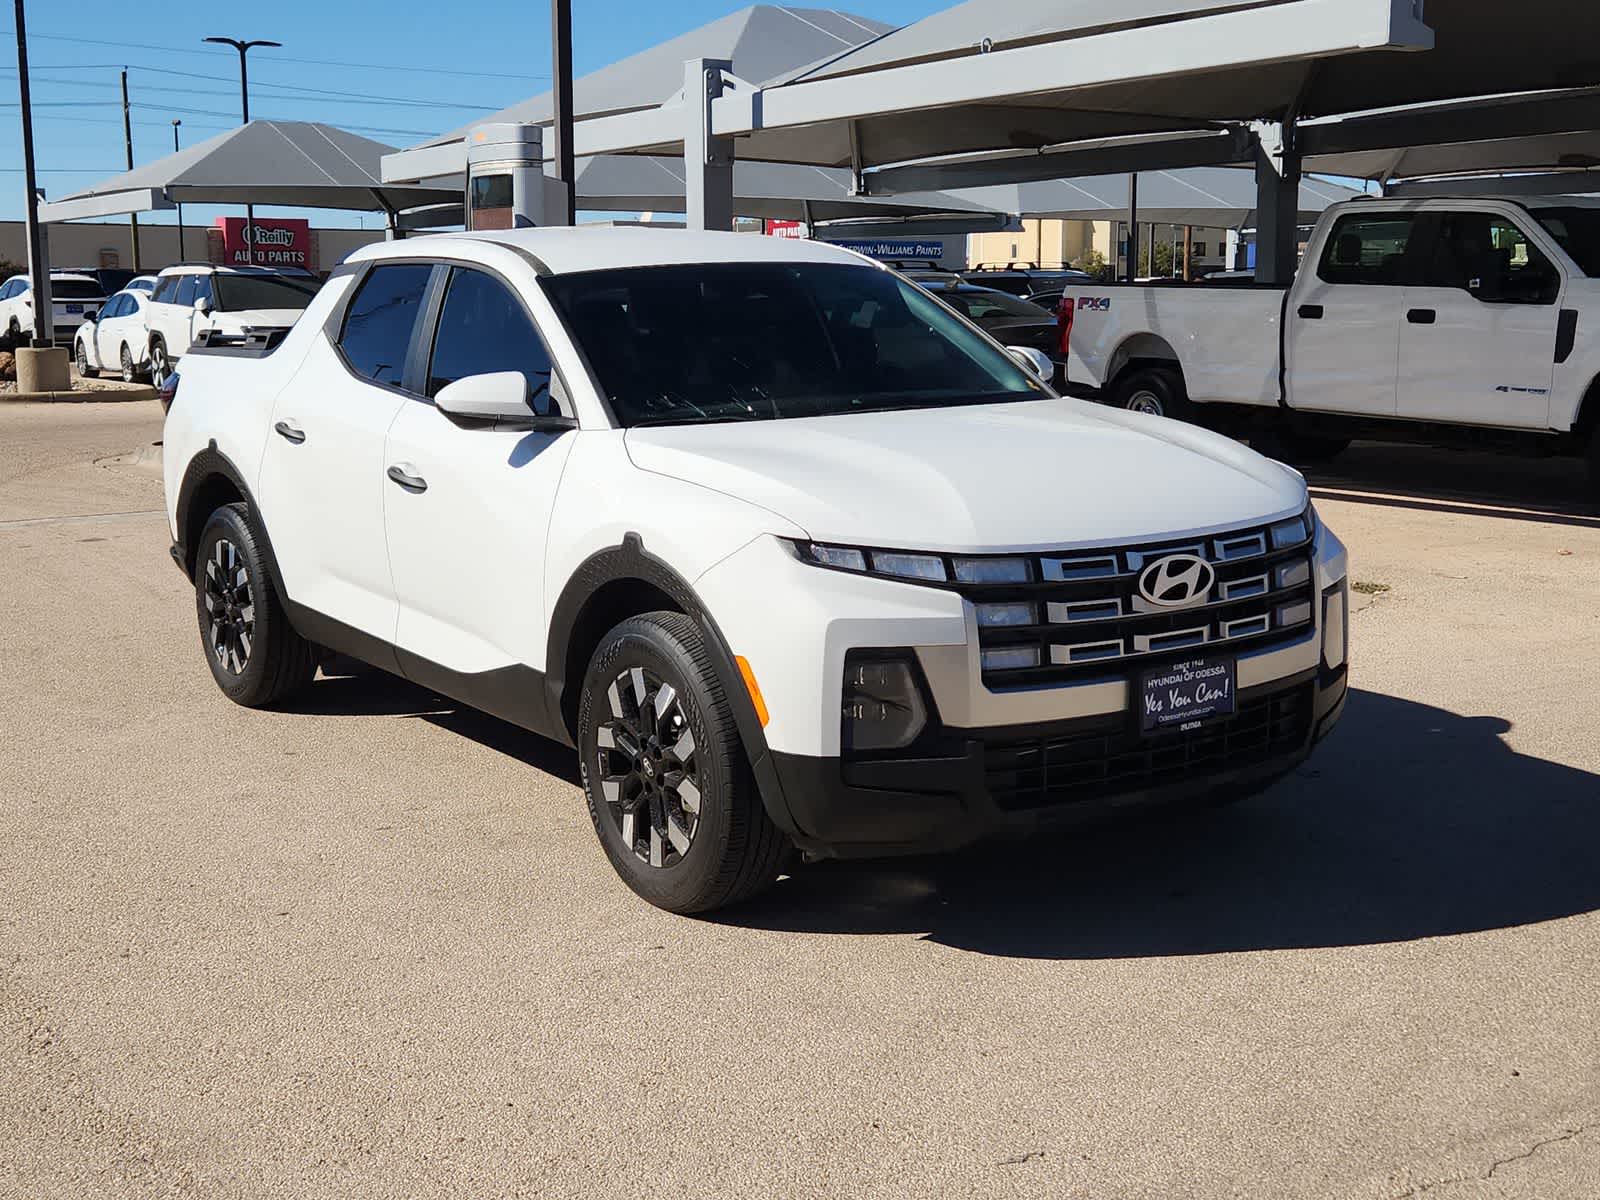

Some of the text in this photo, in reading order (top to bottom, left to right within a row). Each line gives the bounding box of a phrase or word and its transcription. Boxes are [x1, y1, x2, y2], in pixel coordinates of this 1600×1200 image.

[268, 251, 304, 262] PARTS
[915, 245, 942, 256] PAINTS
[1078, 297, 1110, 309] FX4
[1147, 665, 1226, 689] HYUNDAI OF ODESSA
[1145, 678, 1230, 715] Yes You Can!
